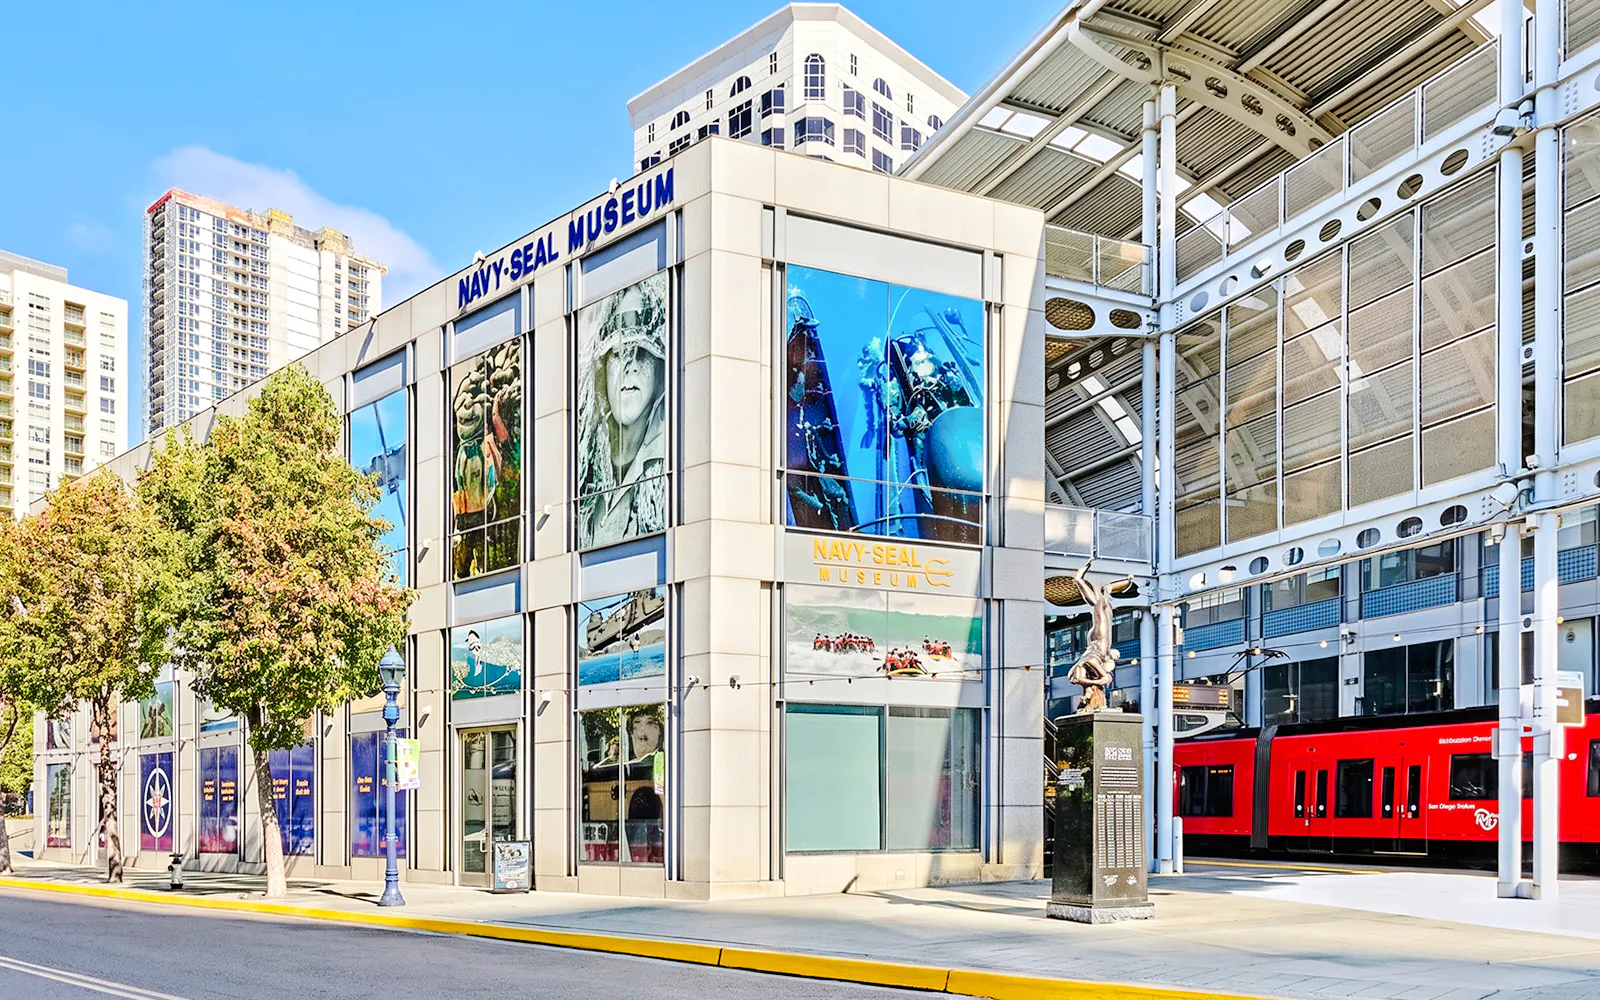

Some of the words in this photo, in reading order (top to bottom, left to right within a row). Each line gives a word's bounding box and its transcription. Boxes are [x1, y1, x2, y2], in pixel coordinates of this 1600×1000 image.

[568, 167, 674, 253] MUSEUM
[813, 538, 922, 568] NAVY-SEAL
[819, 566, 917, 588] MUSEUM
